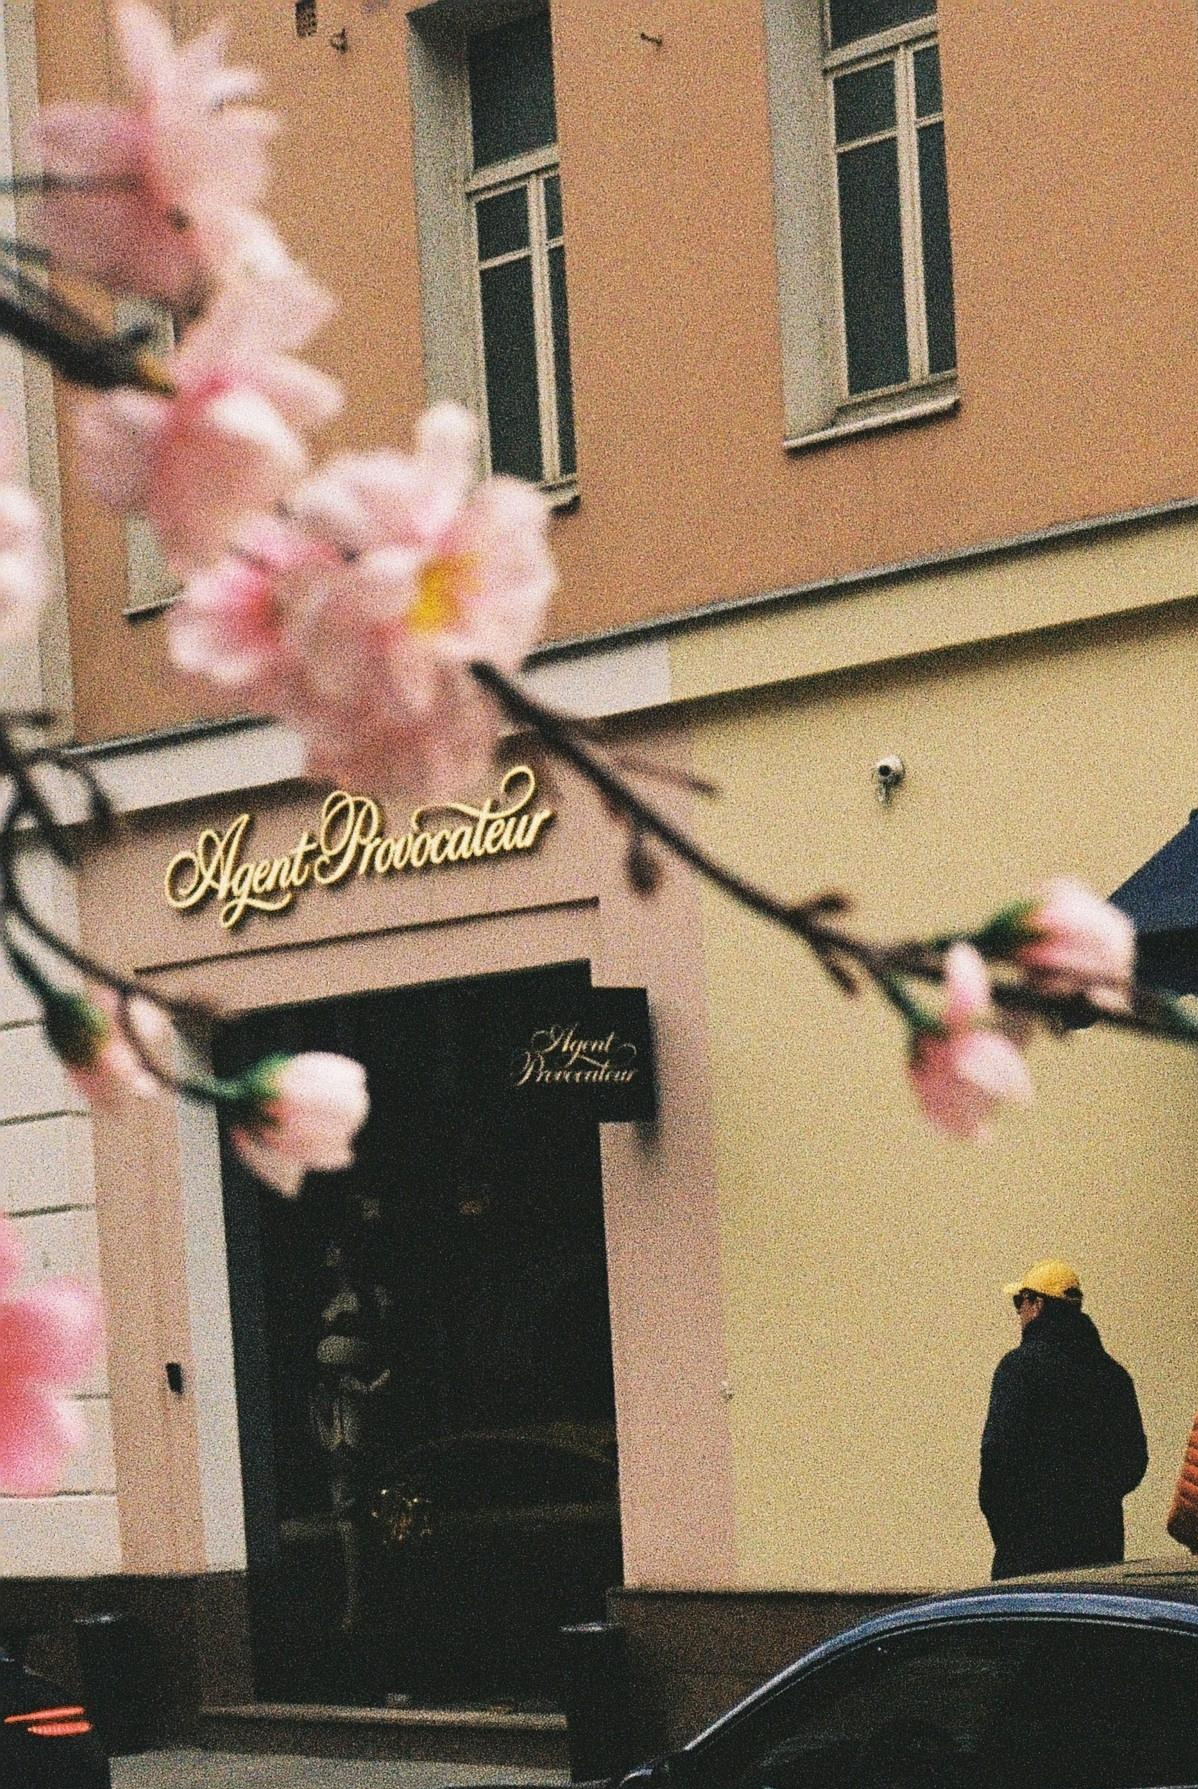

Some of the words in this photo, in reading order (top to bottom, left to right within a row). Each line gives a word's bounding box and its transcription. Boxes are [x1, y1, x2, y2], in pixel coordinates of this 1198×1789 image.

[164, 813, 318, 930] Agent
[313, 765, 556, 886] Provocateur
[529, 1022, 615, 1069] Agent
